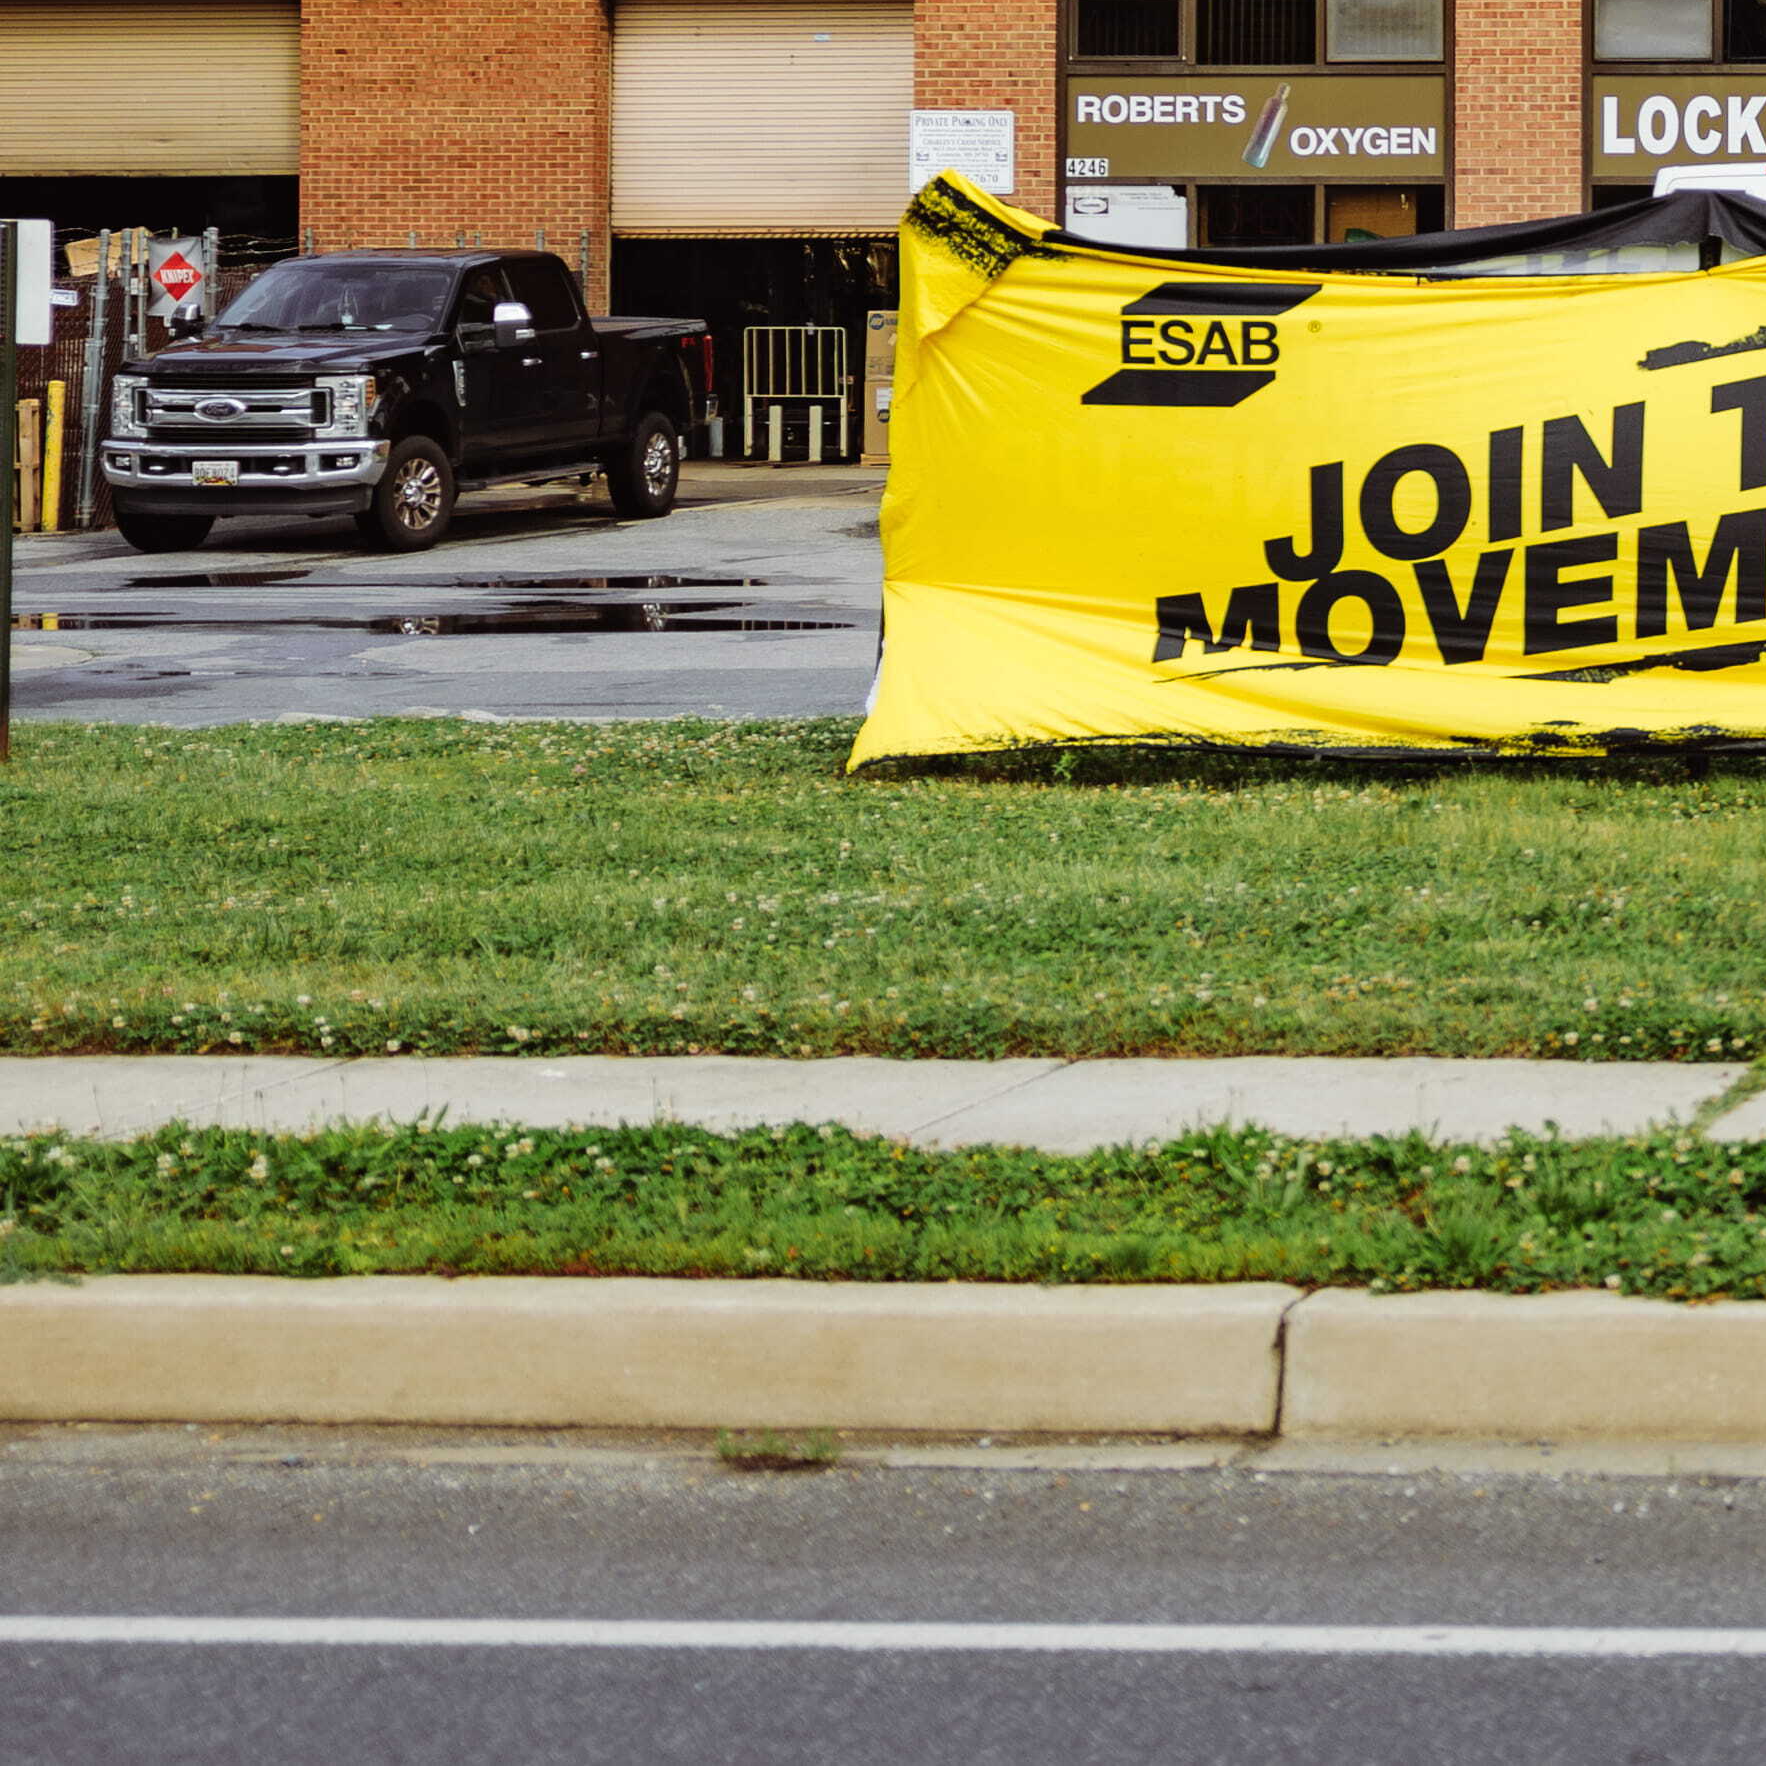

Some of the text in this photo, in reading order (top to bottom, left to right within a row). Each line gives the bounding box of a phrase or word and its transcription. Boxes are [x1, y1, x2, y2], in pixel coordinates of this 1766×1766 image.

[1076, 95, 1246, 124] ROBERTS
[1289, 127, 1437, 156] OXYGEN
[1068, 159, 1107, 176] 4246
[1120, 319, 1280, 367] ESAB
[1264, 399, 1647, 584] JOIN
